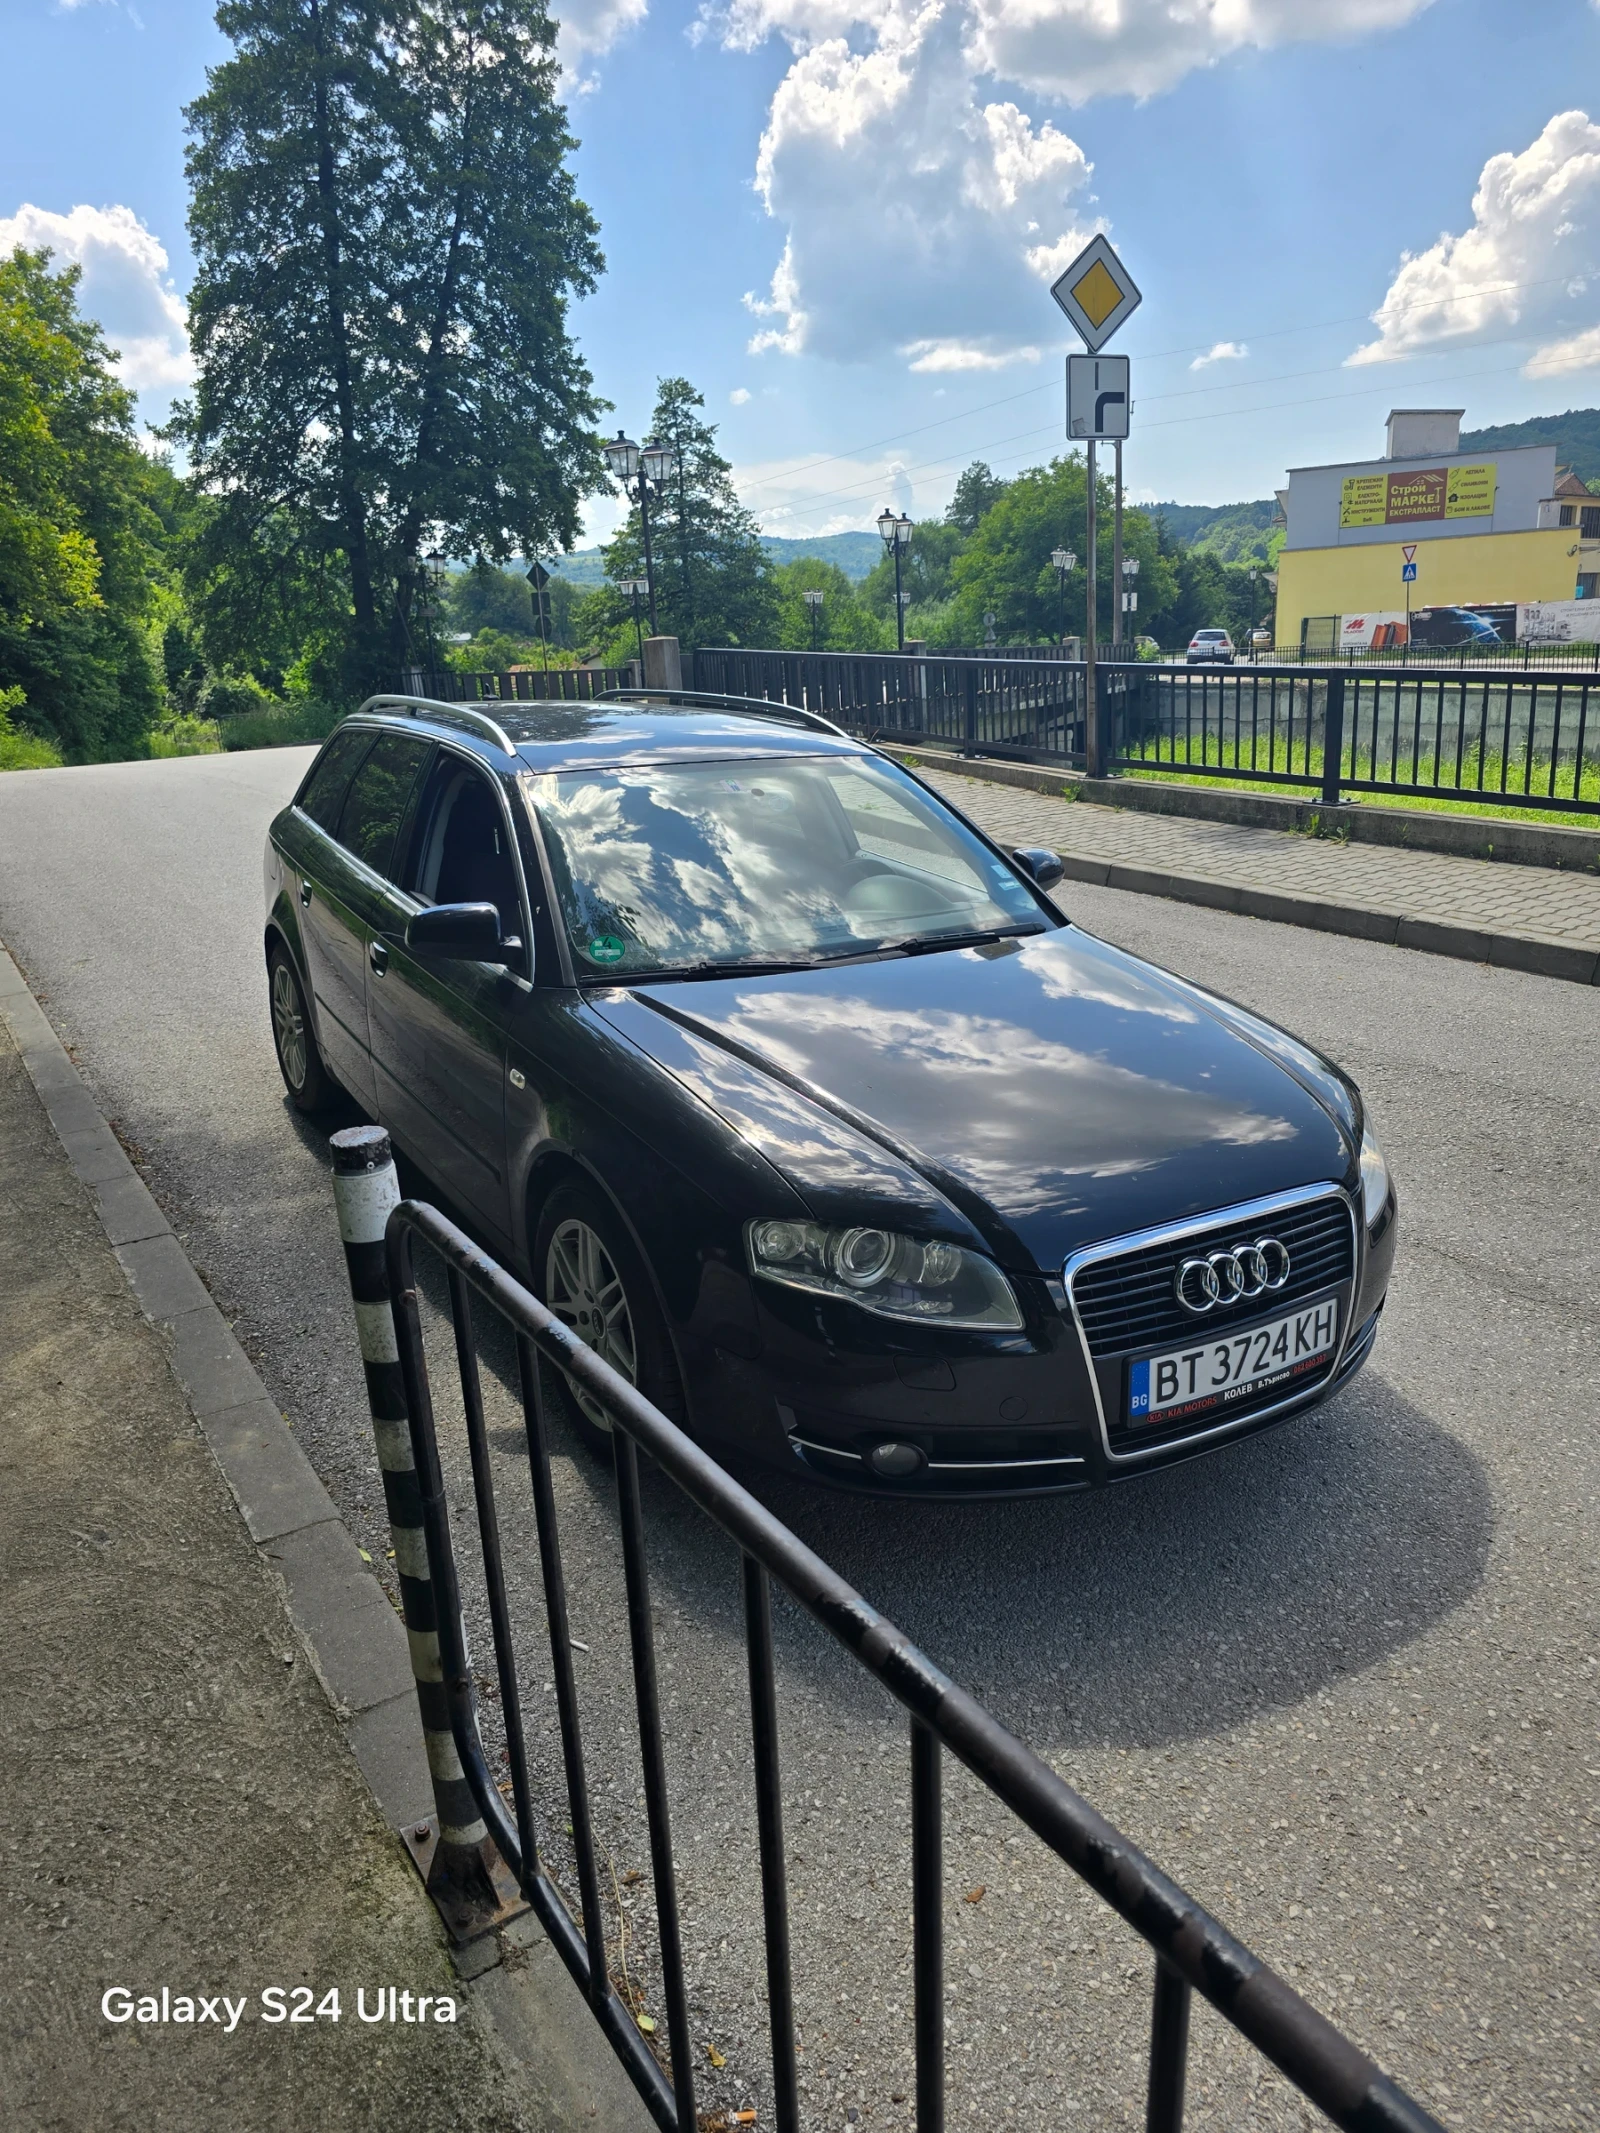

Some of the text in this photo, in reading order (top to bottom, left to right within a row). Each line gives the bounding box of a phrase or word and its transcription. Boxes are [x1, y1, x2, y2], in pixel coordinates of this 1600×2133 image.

[1389, 505, 1441, 516] ЕКСТРАПЛАСТ
[603, 937, 612, 949] 4
[1156, 1304, 1333, 1404] BT 3724 KH
[1224, 1383, 1253, 1401] КОЛЕВ
[1257, 1371, 1290, 1389] В.Търново
[1132, 1393, 1148, 1409] BG
[1167, 1408, 1182, 1418] KIA
[1184, 1396, 1217, 1413] MOTORS
